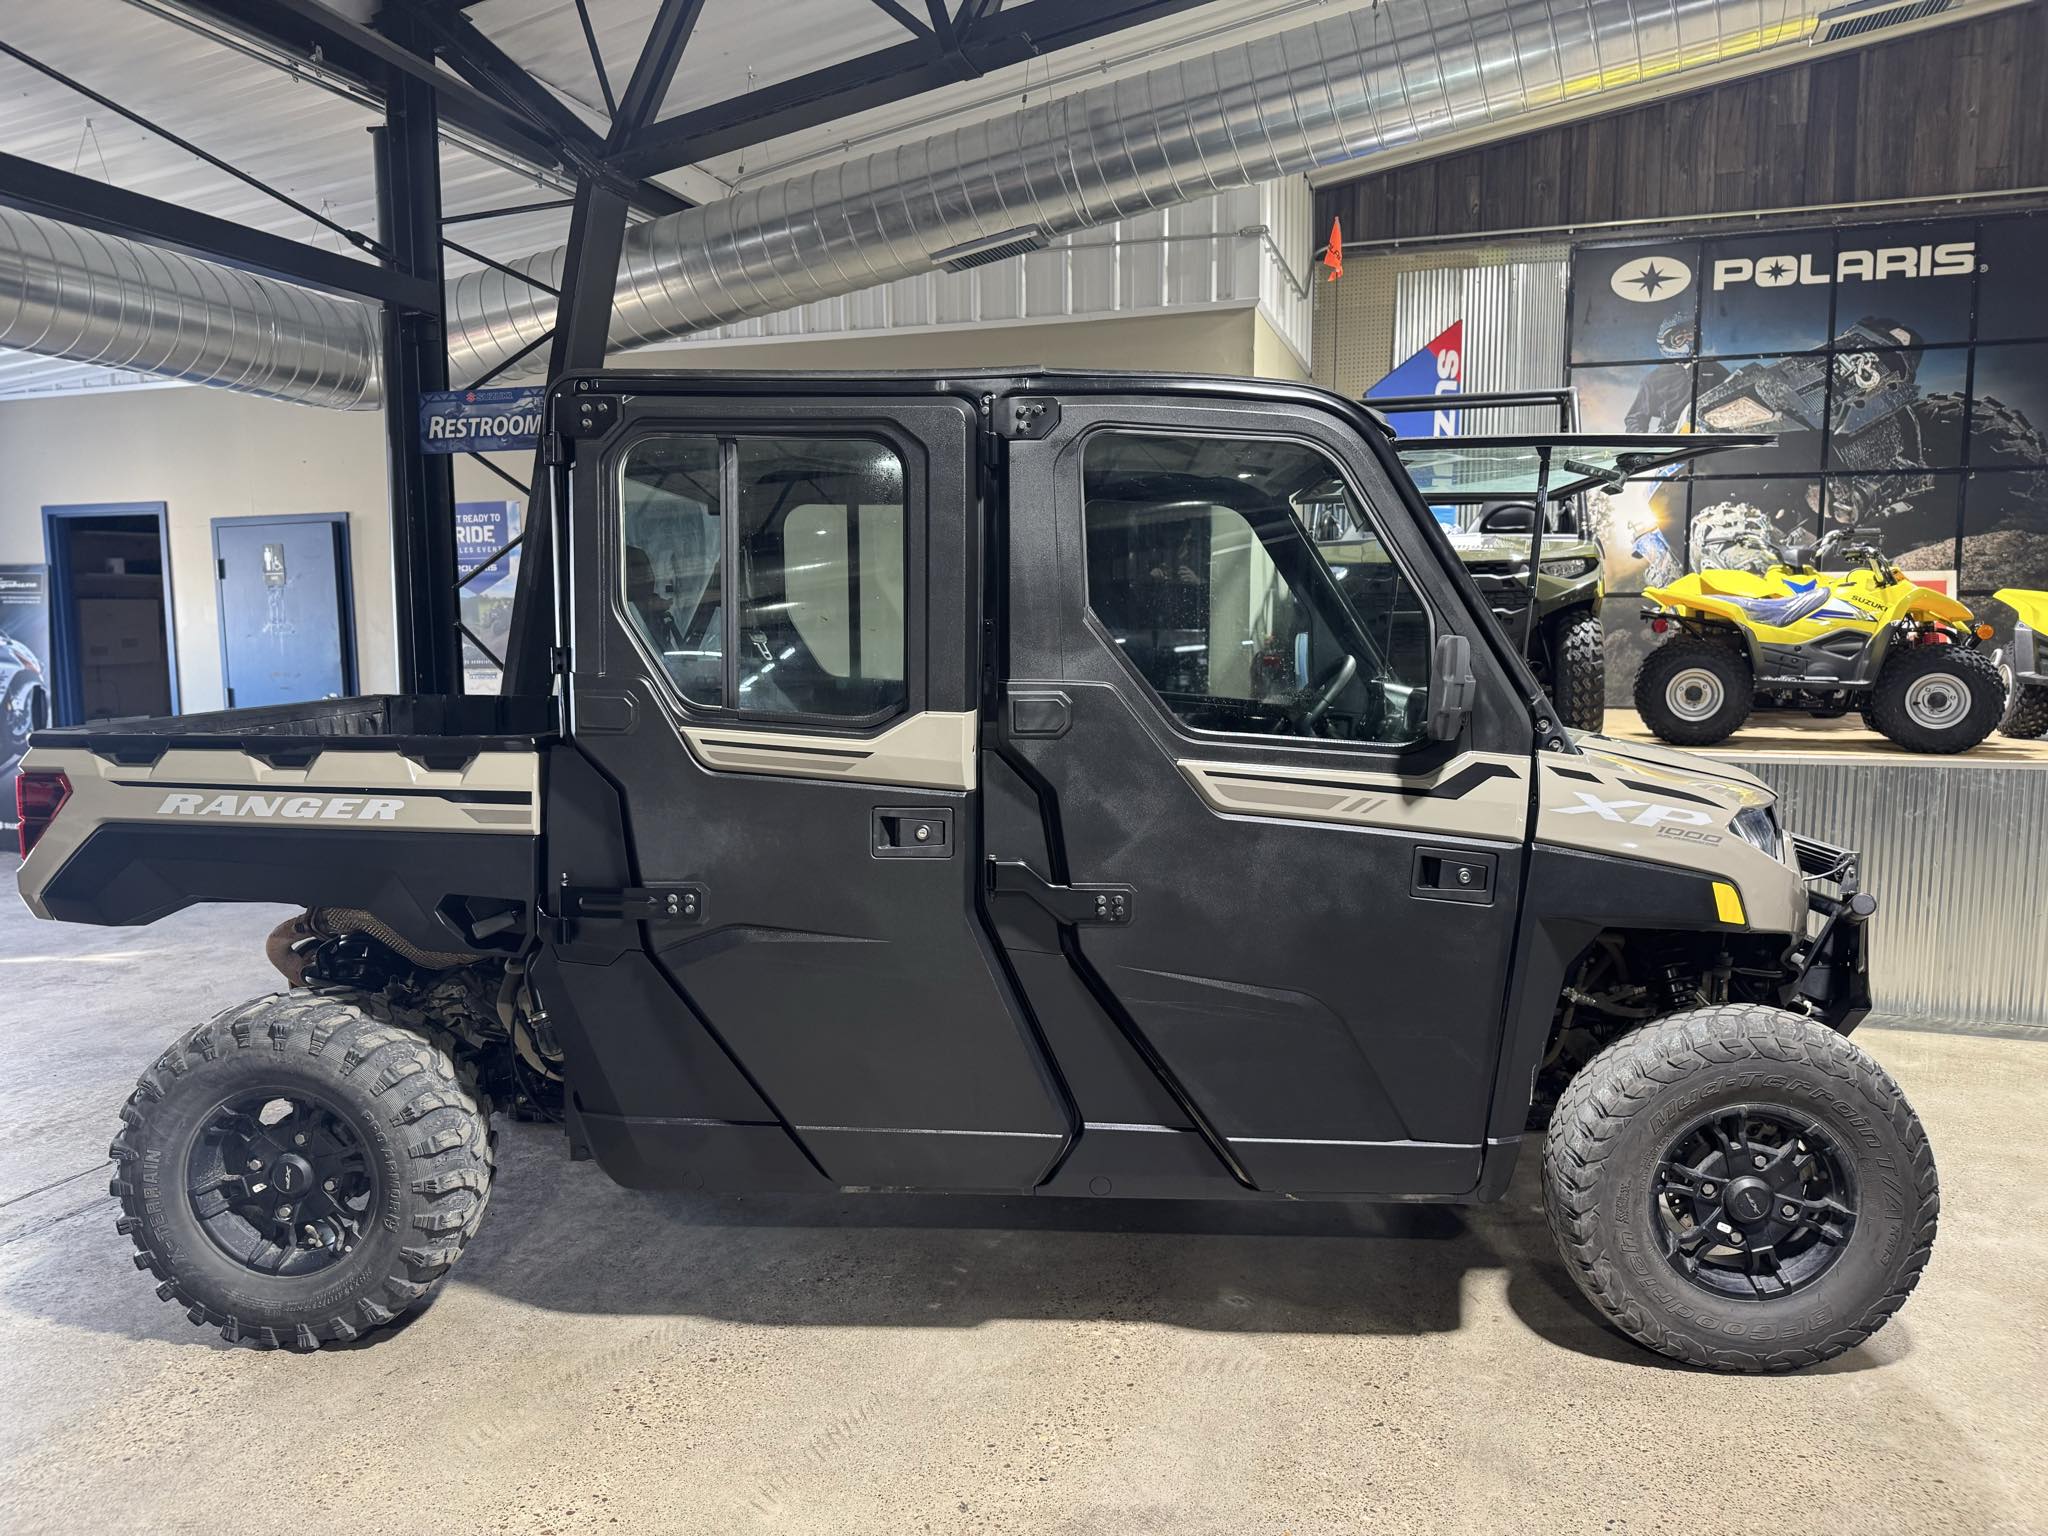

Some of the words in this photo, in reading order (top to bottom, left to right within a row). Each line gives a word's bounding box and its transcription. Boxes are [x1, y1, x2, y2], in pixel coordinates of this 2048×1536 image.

[1713, 242, 1975, 291] POLARIS
[462, 513, 488, 523] READY
[490, 513, 501, 522] TO
[456, 525, 496, 544] RIDE
[1852, 595, 1888, 612] SUZUKI
[156, 793, 405, 820] RANGER
[1549, 791, 1713, 827] XP
[1658, 825, 1723, 843] 1000
